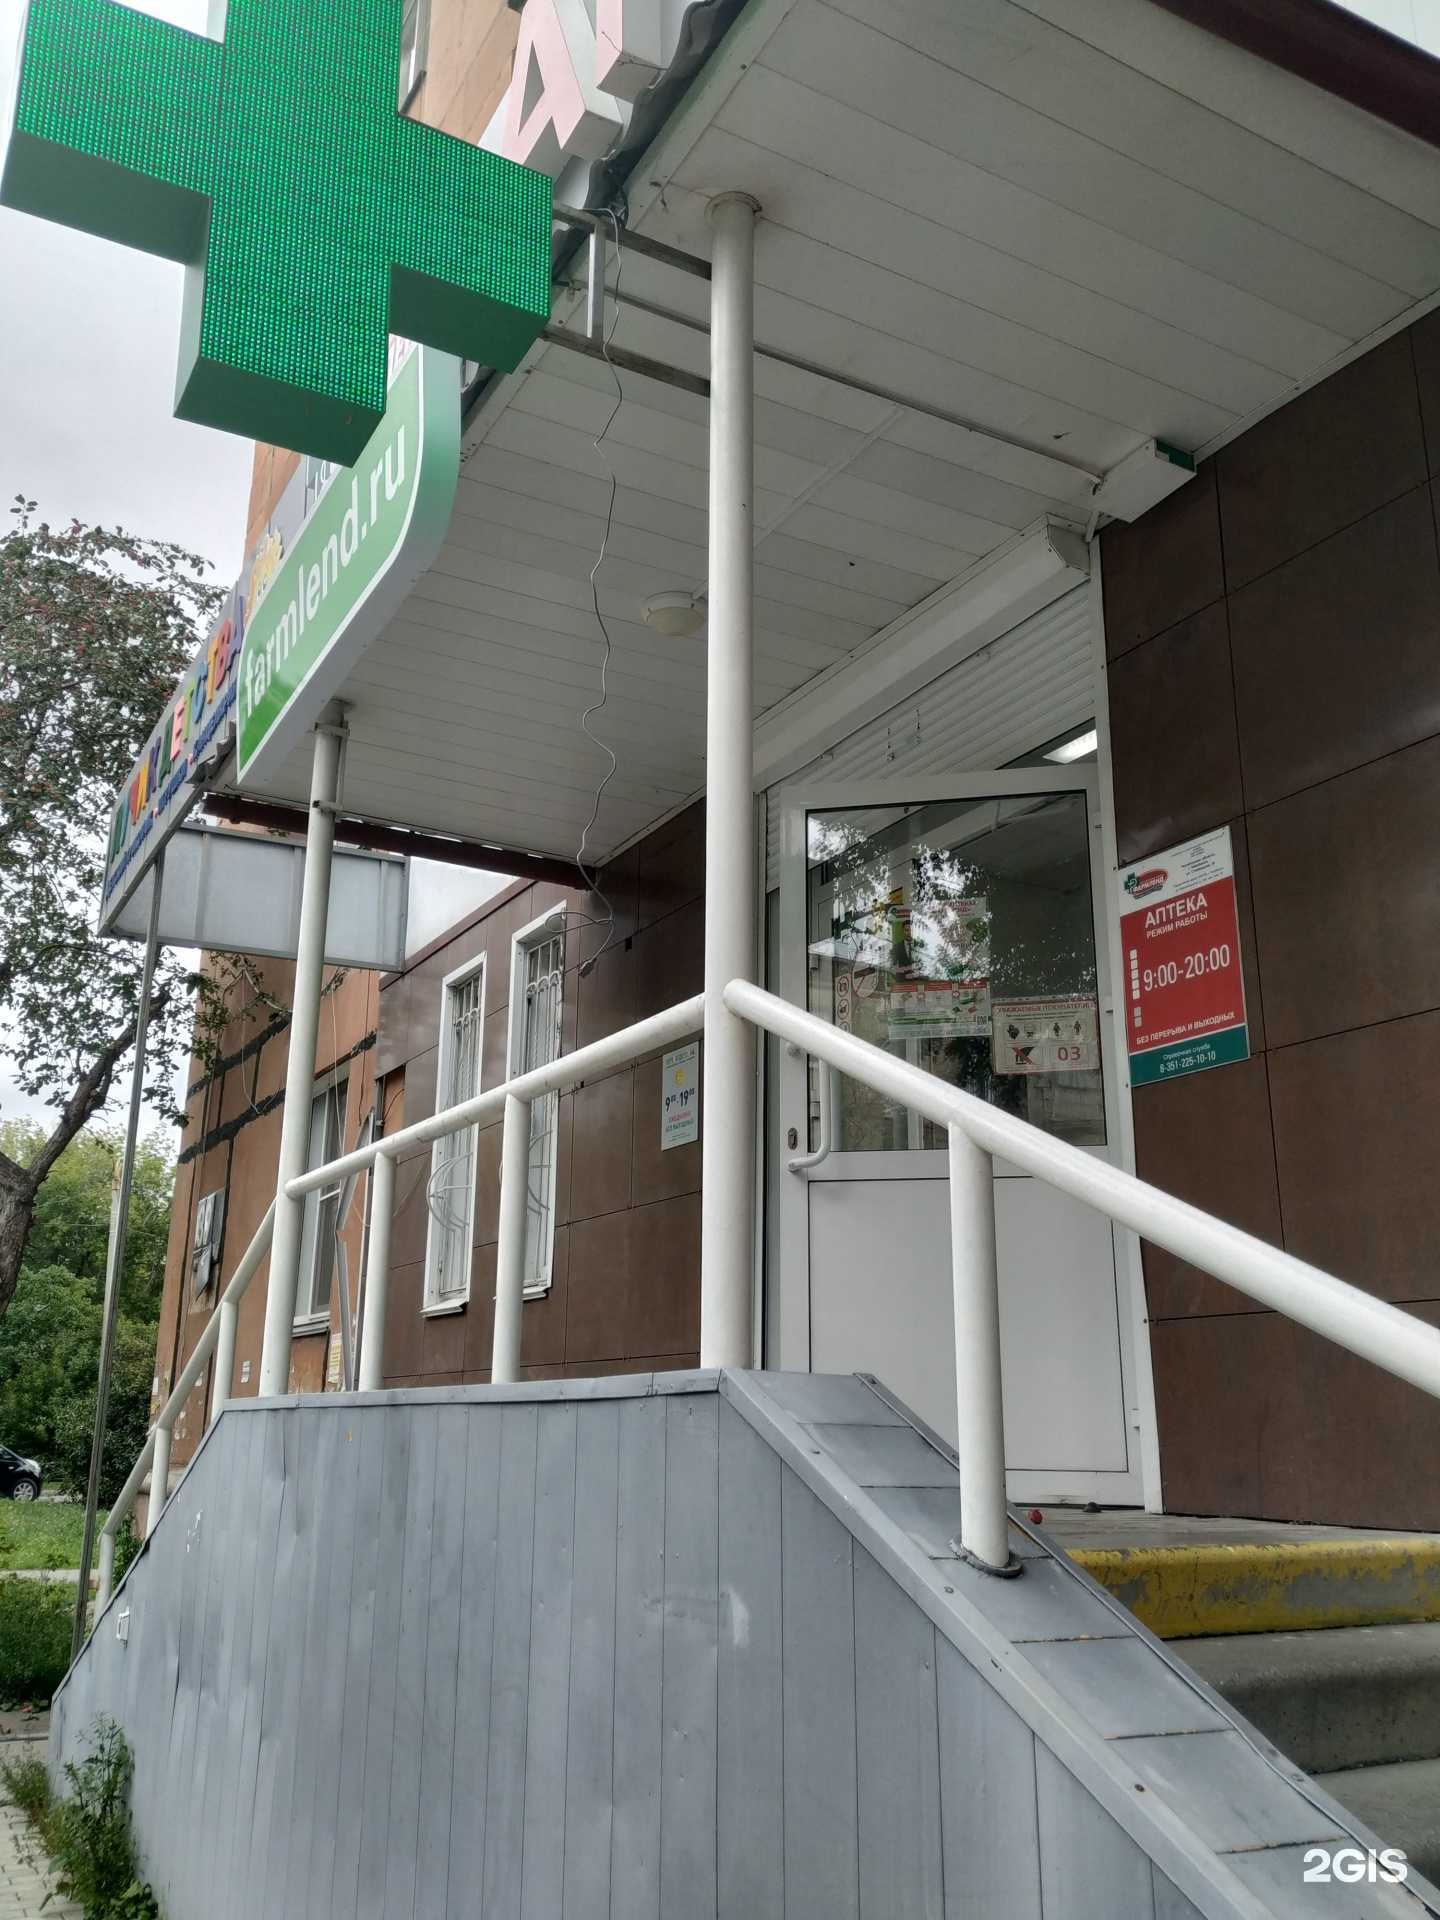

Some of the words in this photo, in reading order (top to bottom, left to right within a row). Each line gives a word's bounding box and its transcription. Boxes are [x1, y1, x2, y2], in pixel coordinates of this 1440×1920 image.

[244, 423, 407, 718] farmlend.ru
[1144, 892, 1208, 929] АПТЕКА
[1146, 922, 1174, 939] РЕЖИМ
[1175, 910, 1208, 930] РАБОТЫ
[1143, 944, 1230, 992] 9:00-20:00
[1136, 1035, 1150, 1045] БЕЗ
[1150, 1025, 1187, 1042] ПЕРЕРЫВА
[1187, 1023, 1193, 1031] И
[1193, 1011, 1235, 1030] ВЫХОДНЫХ
[1057, 1046, 1081, 1061] 03
[1159, 1050, 1217, 1073] 8-351-225-10-10
